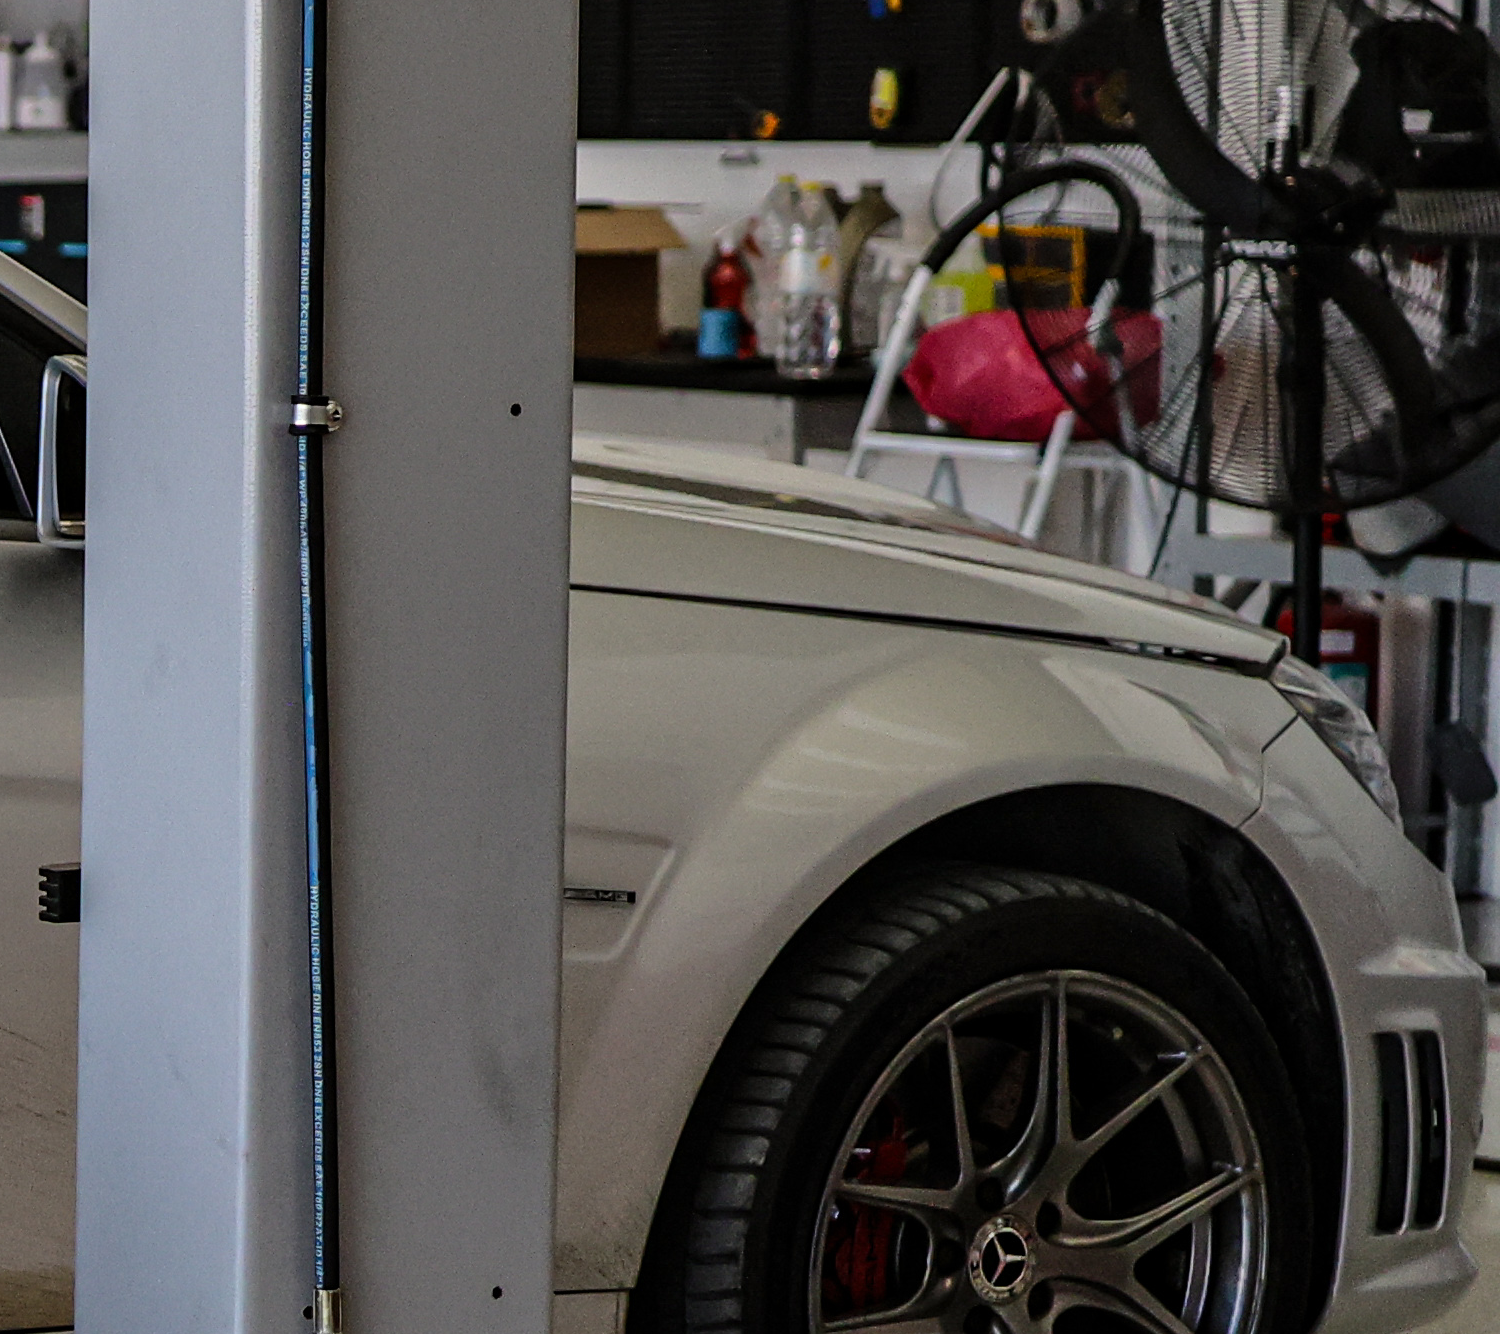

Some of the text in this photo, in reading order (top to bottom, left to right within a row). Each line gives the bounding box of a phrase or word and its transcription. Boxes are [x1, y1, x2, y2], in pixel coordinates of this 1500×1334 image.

[301, 67, 311, 138] HYDRAULIC
[301, 142, 310, 175] HOSE
[300, 178, 310, 199] DIN
[298, 295, 308, 351] EXCEEDS
[298, 355, 307, 379] SAE
[298, 383, 306, 395] 10
[308, 886, 319, 955] HYDRAULIC
[310, 958, 320, 991] HOSE
[312, 993, 321, 1013] DIN
[312, 1016, 322, 1053] EN853
[313, 1106, 322, 1161] EXCEEDS
